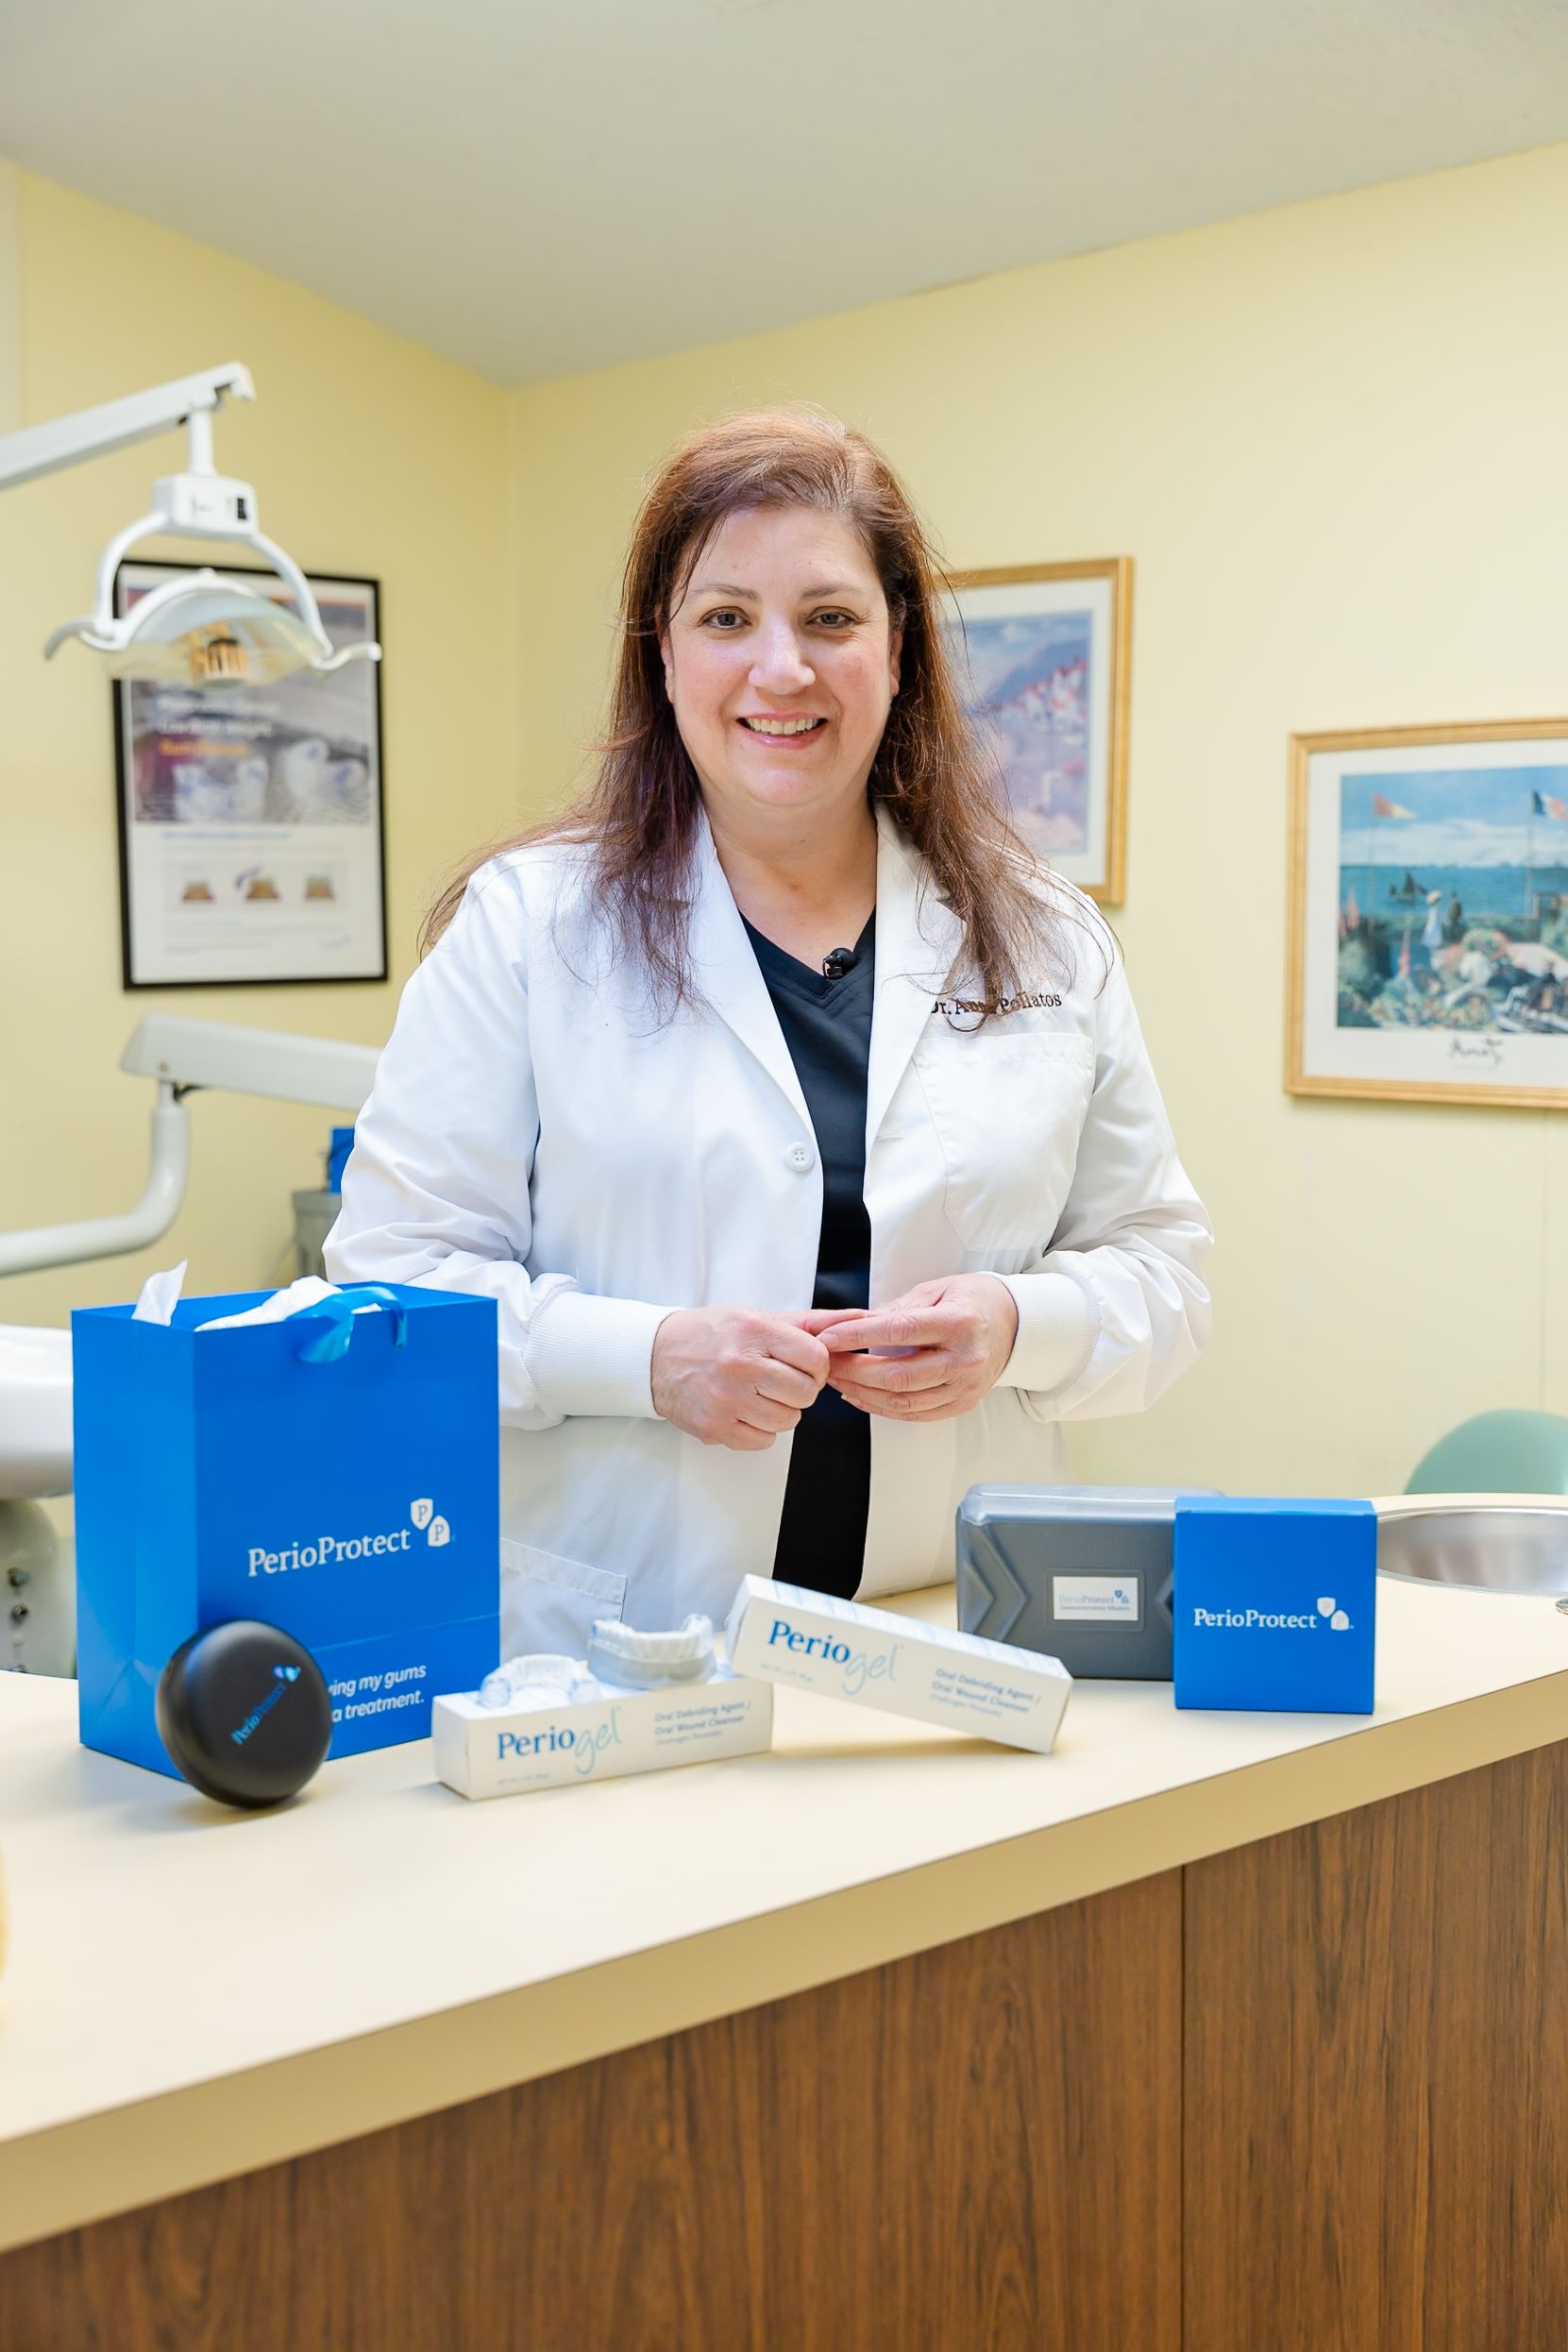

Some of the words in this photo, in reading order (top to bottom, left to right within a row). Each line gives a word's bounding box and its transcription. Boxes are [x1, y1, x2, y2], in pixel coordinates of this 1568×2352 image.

[247, 1529, 412, 1578] PerioProtect
[1193, 1608, 1318, 1629] PerioProtect
[767, 1618, 898, 1695] Periogel
[358, 1674, 383, 1693] my
[384, 1665, 428, 1689] gums
[345, 1690, 425, 1720] treatment.
[497, 1707, 622, 1775] Periogel
